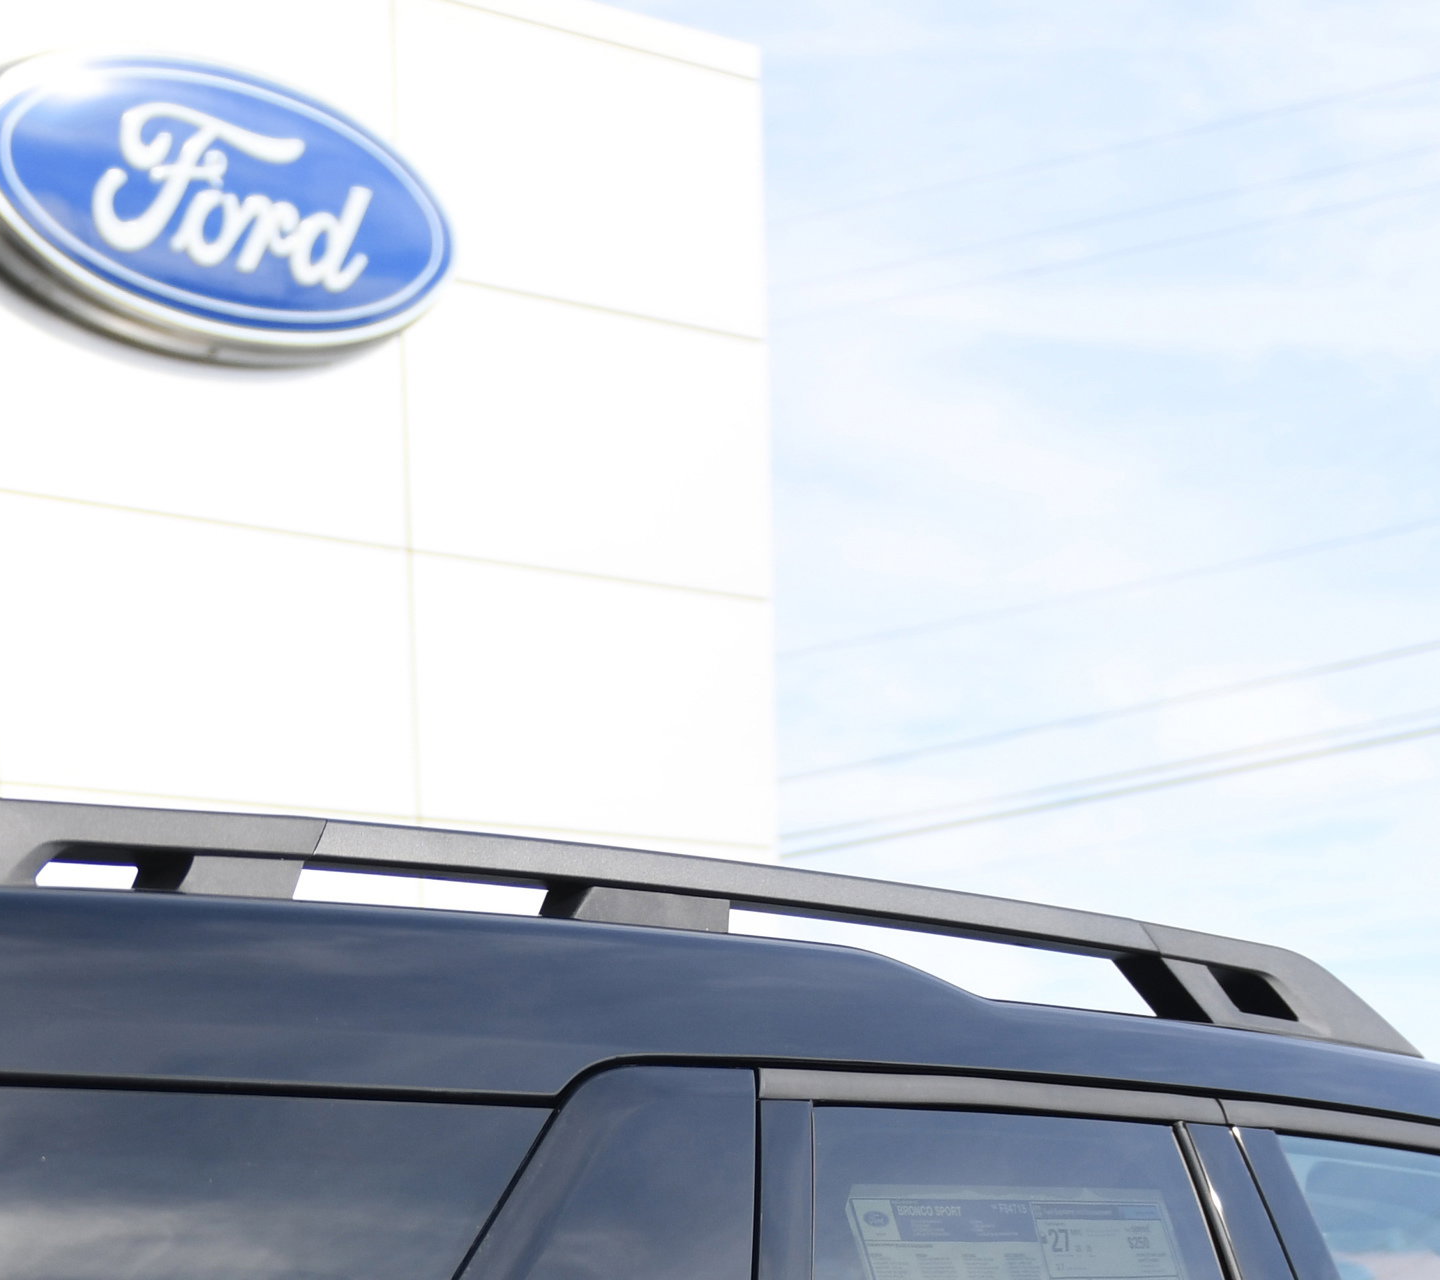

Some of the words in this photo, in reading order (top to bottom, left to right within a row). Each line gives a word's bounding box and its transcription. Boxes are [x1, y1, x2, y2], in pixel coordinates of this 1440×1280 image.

[92, 102, 373, 292] Ford
[896, 1205, 933, 1217] BRONCO
[935, 1205, 962, 1217] SPORT
[1047, 1228, 1070, 1253] 27
